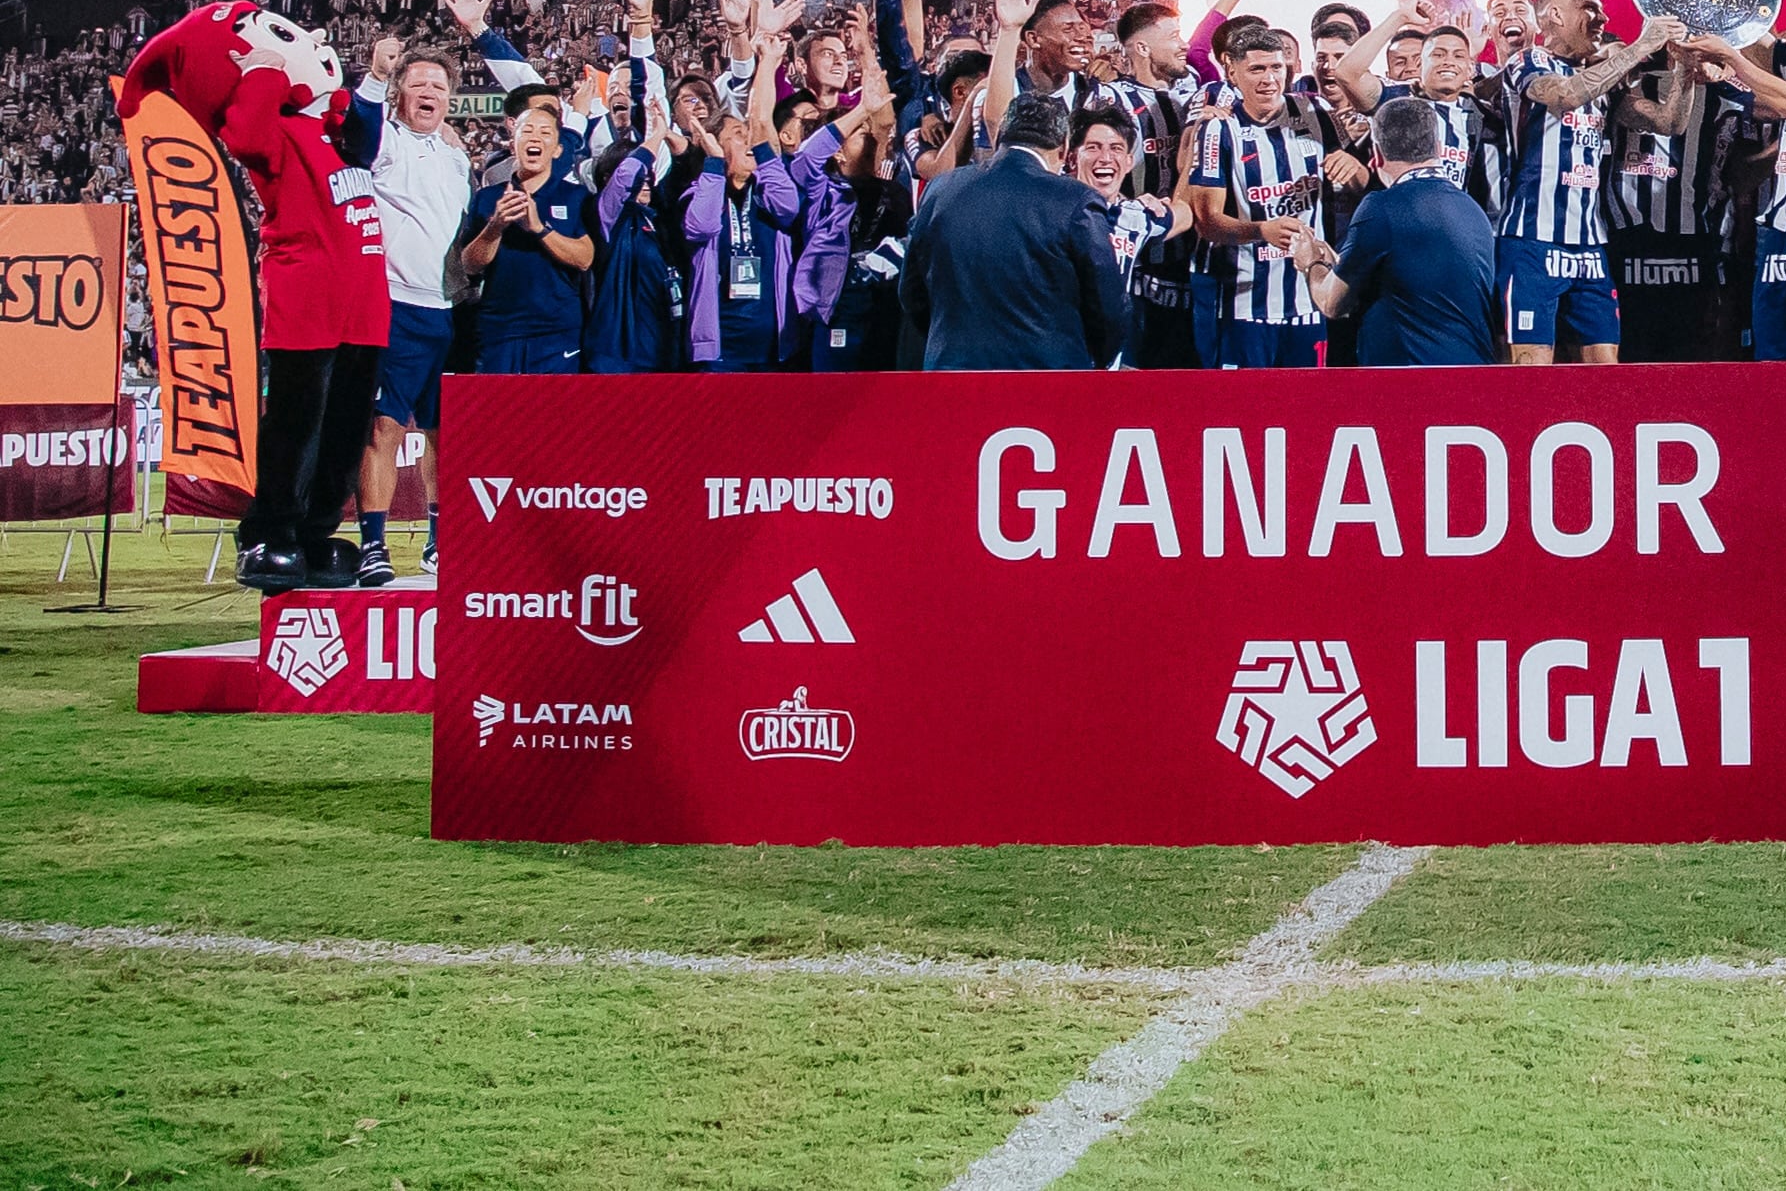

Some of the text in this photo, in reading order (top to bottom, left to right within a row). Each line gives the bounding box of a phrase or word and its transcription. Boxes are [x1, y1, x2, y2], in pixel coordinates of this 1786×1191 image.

[448, 96, 504, 115] SALID
[1249, 175, 1320, 203] apuesta
[1267, 195, 1312, 218] total
[1624, 258, 1700, 285] ilumi
[516, 483, 648, 518] vantage
[977, 421, 1726, 560] GANADOR
[465, 573, 639, 626] smart fit
[513, 703, 633, 726] LATAM
[512, 735, 633, 751] AIRLINES
[748, 716, 845, 753] CRISTAL
